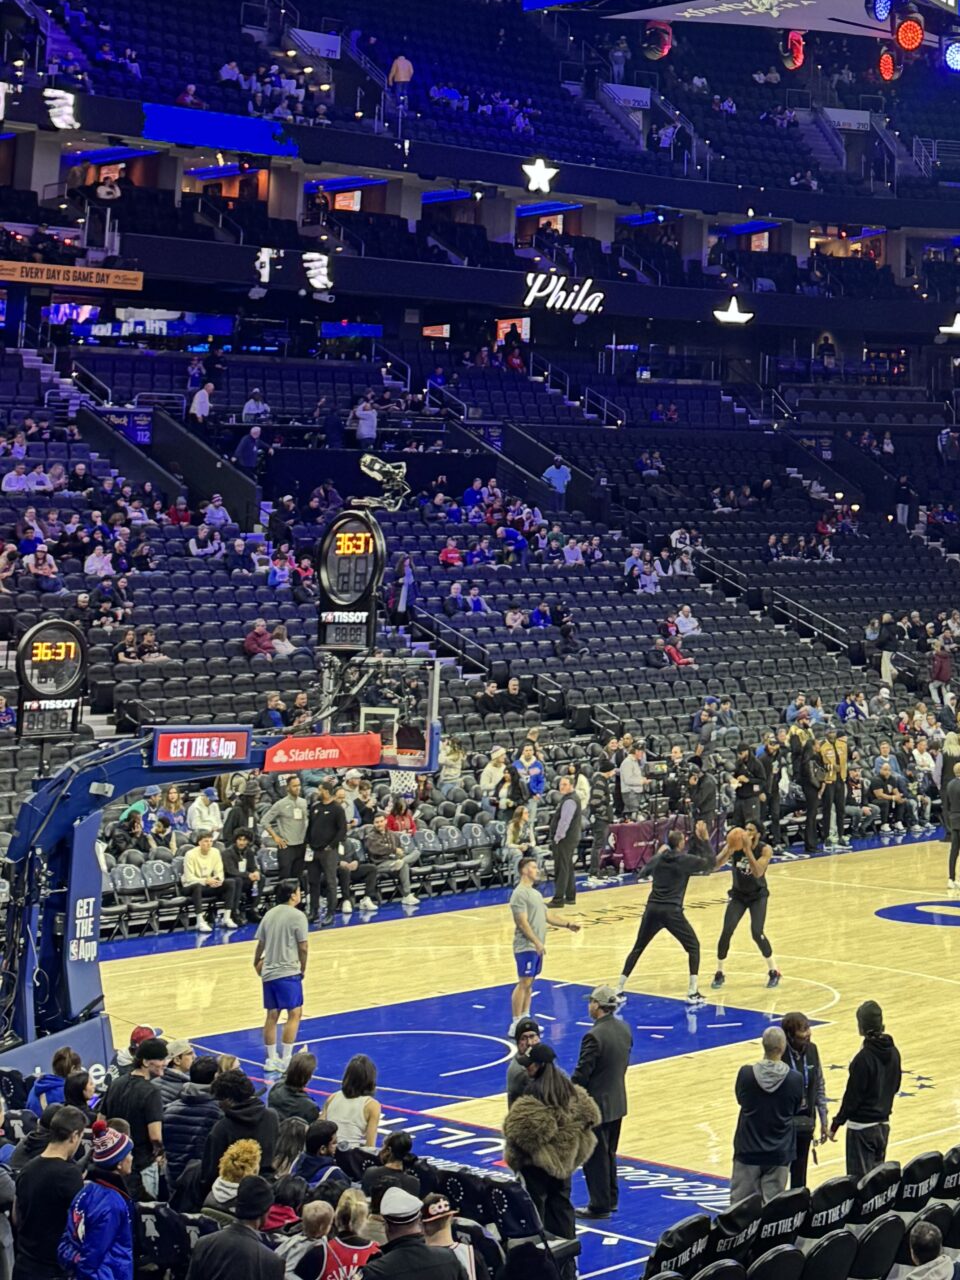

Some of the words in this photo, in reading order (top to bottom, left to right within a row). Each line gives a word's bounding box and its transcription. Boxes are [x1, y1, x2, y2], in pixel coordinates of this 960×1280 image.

[20, 266, 45, 279] EVERY
[46, 268, 61, 280] DAY
[63, 270, 71, 281] IS
[72, 271, 94, 283] GAME
[96, 273, 110, 284] DAY
[336, 533, 374, 555] 36:37
[333, 611, 369, 623] TISSOT
[31, 641, 76, 662] 36:37
[39, 698, 78, 710] TISSOT
[170, 738, 189, 757] GET
[190, 738, 210, 757] THE
[218, 738, 236, 758] App
[76, 897, 96, 918] GET
[75, 918, 94, 938] THE
[79, 939, 97, 962] App
[903, 1183, 916, 1199] GET
[916, 1178, 930, 1195] THE
[945, 1173, 957, 1189] GET
[862, 1199, 876, 1215] GET
[876, 1193, 890, 1210] THE
[811, 1211, 826, 1227] GET
[827, 1206, 843, 1223] THE
[761, 1222, 777, 1239] GET
[777, 1216, 794, 1235] THE
[717, 1236, 732, 1252] GET
[732, 1229, 748, 1248] THE
[661, 1257, 677, 1271] GET
[675, 1250, 691, 1267] THE
